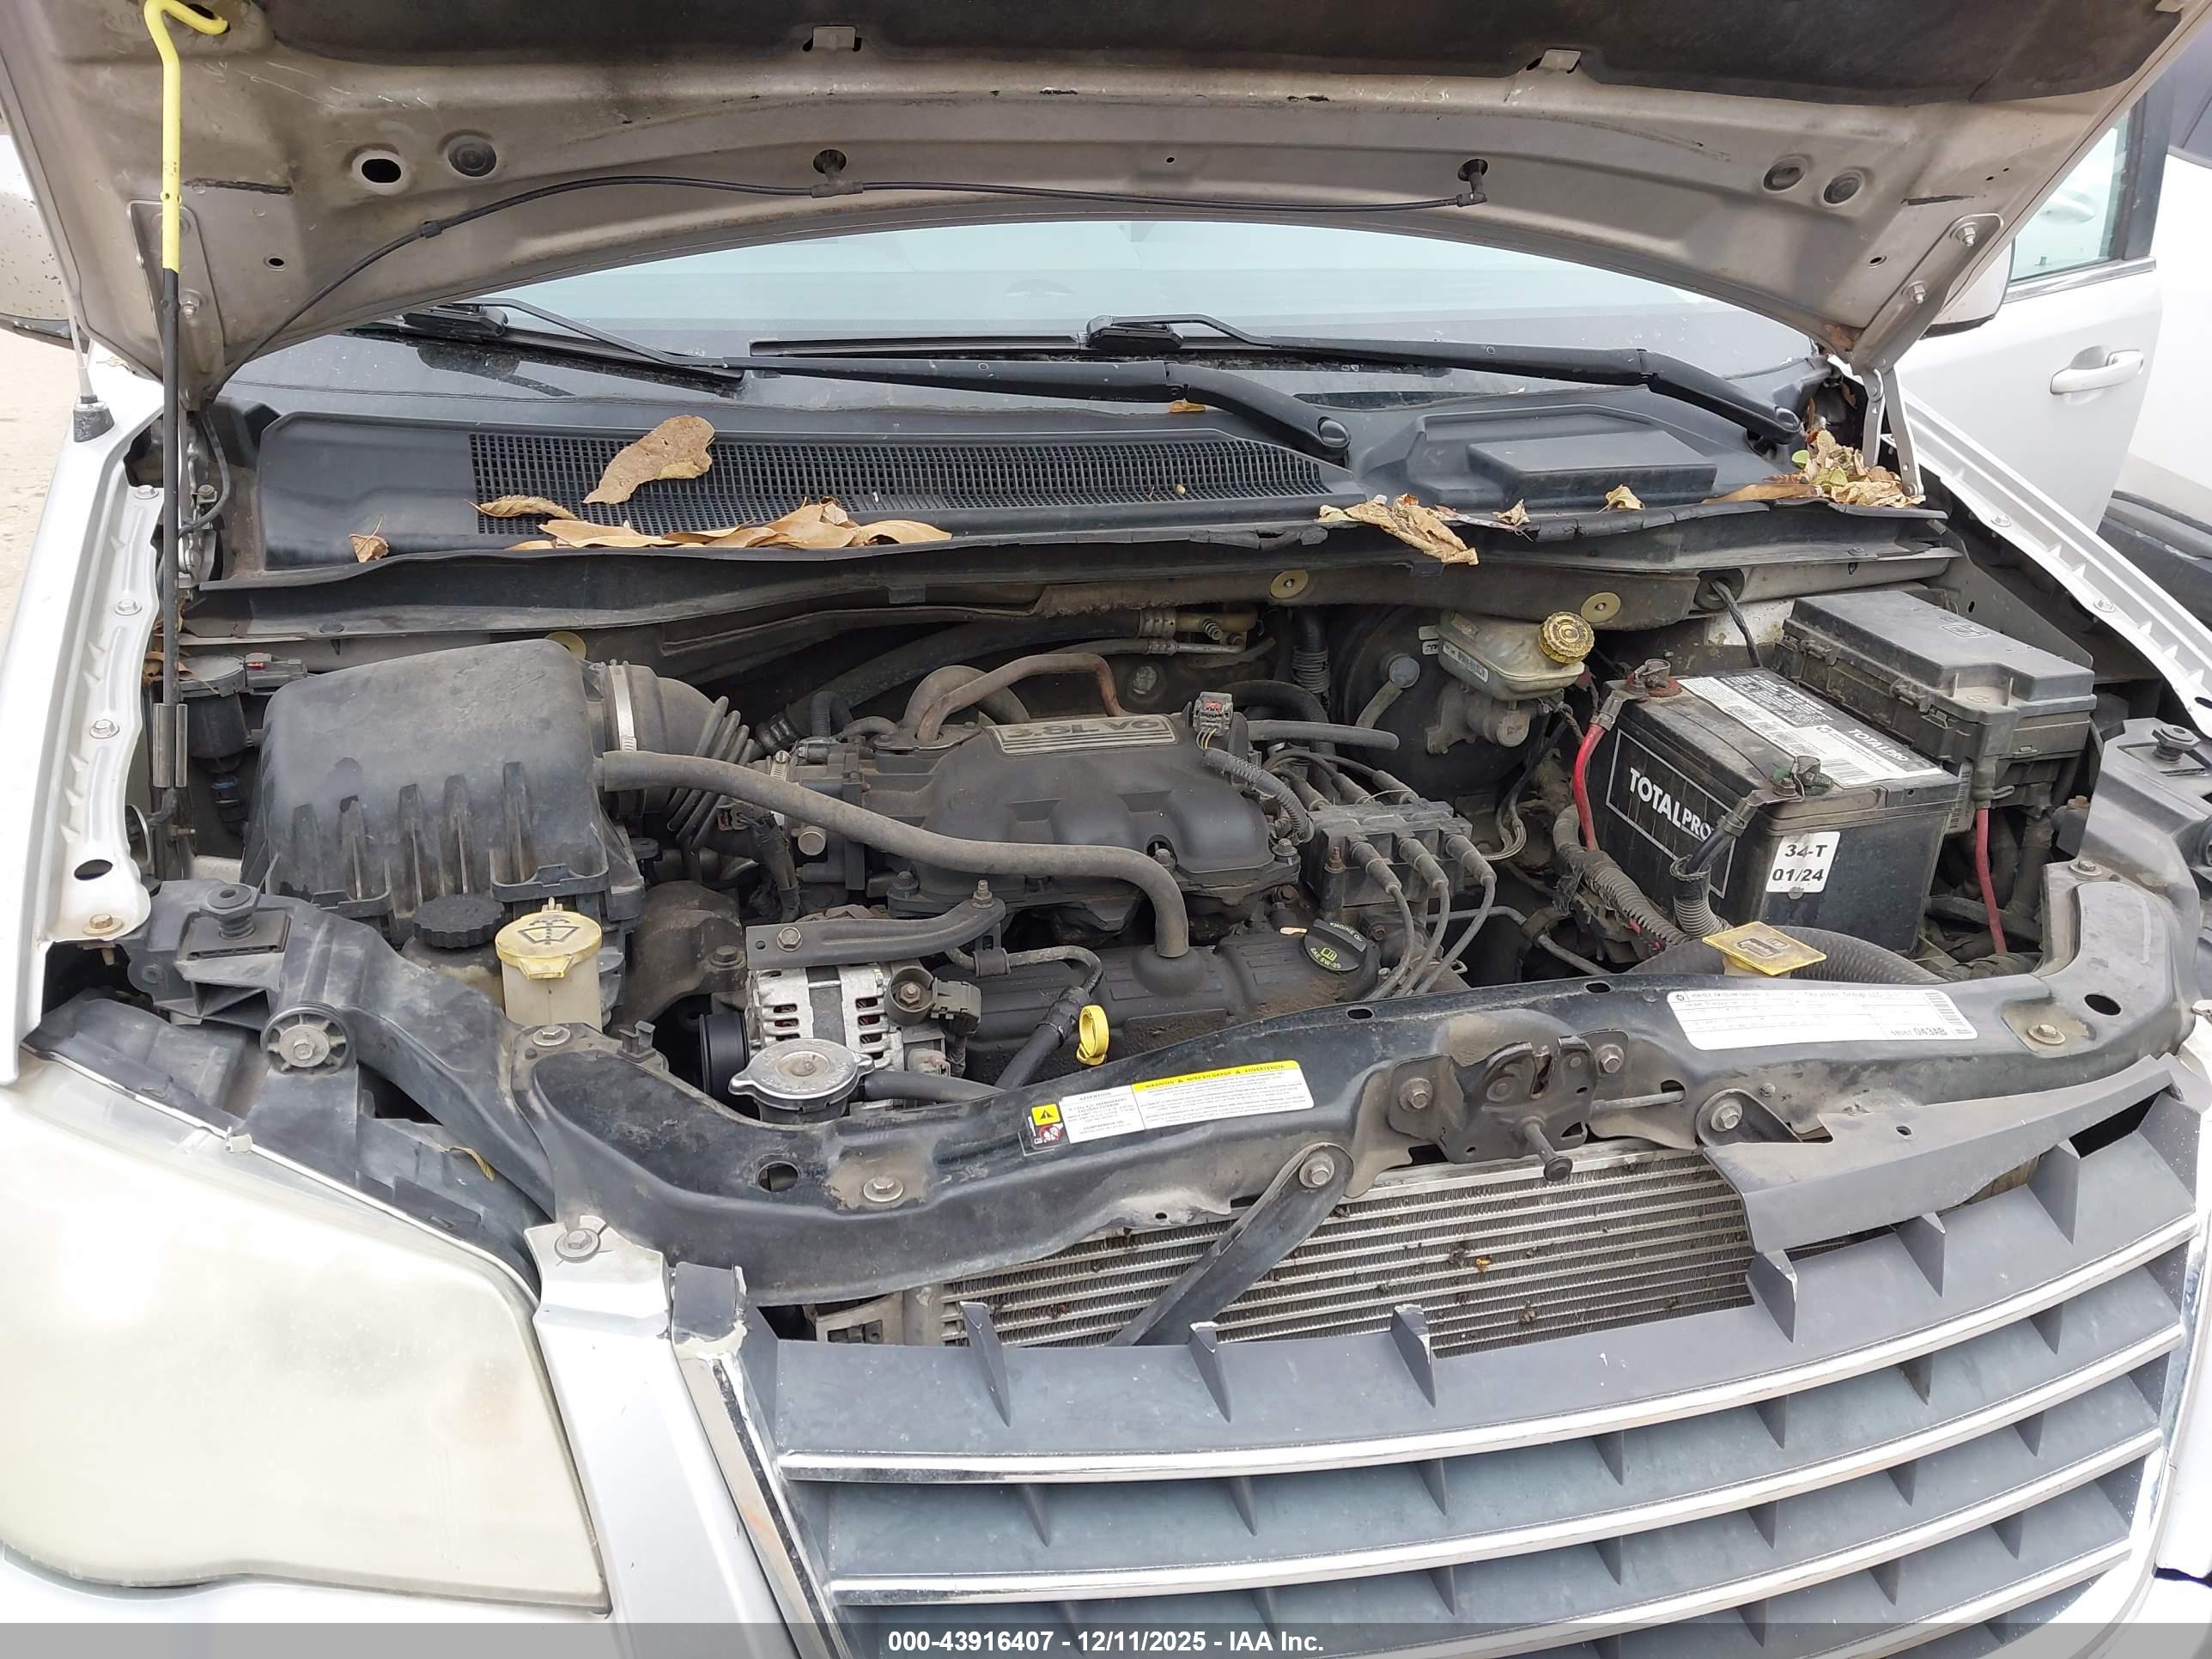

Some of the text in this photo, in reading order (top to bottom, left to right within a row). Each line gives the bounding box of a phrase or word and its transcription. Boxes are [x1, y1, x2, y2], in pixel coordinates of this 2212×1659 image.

[1006, 718, 1159, 738] 3.8L V6
[1847, 728, 1910, 763] TOTALPRO
[1629, 767, 1712, 842] TOTALPRO
[1784, 844, 1827, 858] 34-T
[1771, 866, 1824, 882] 01/24
